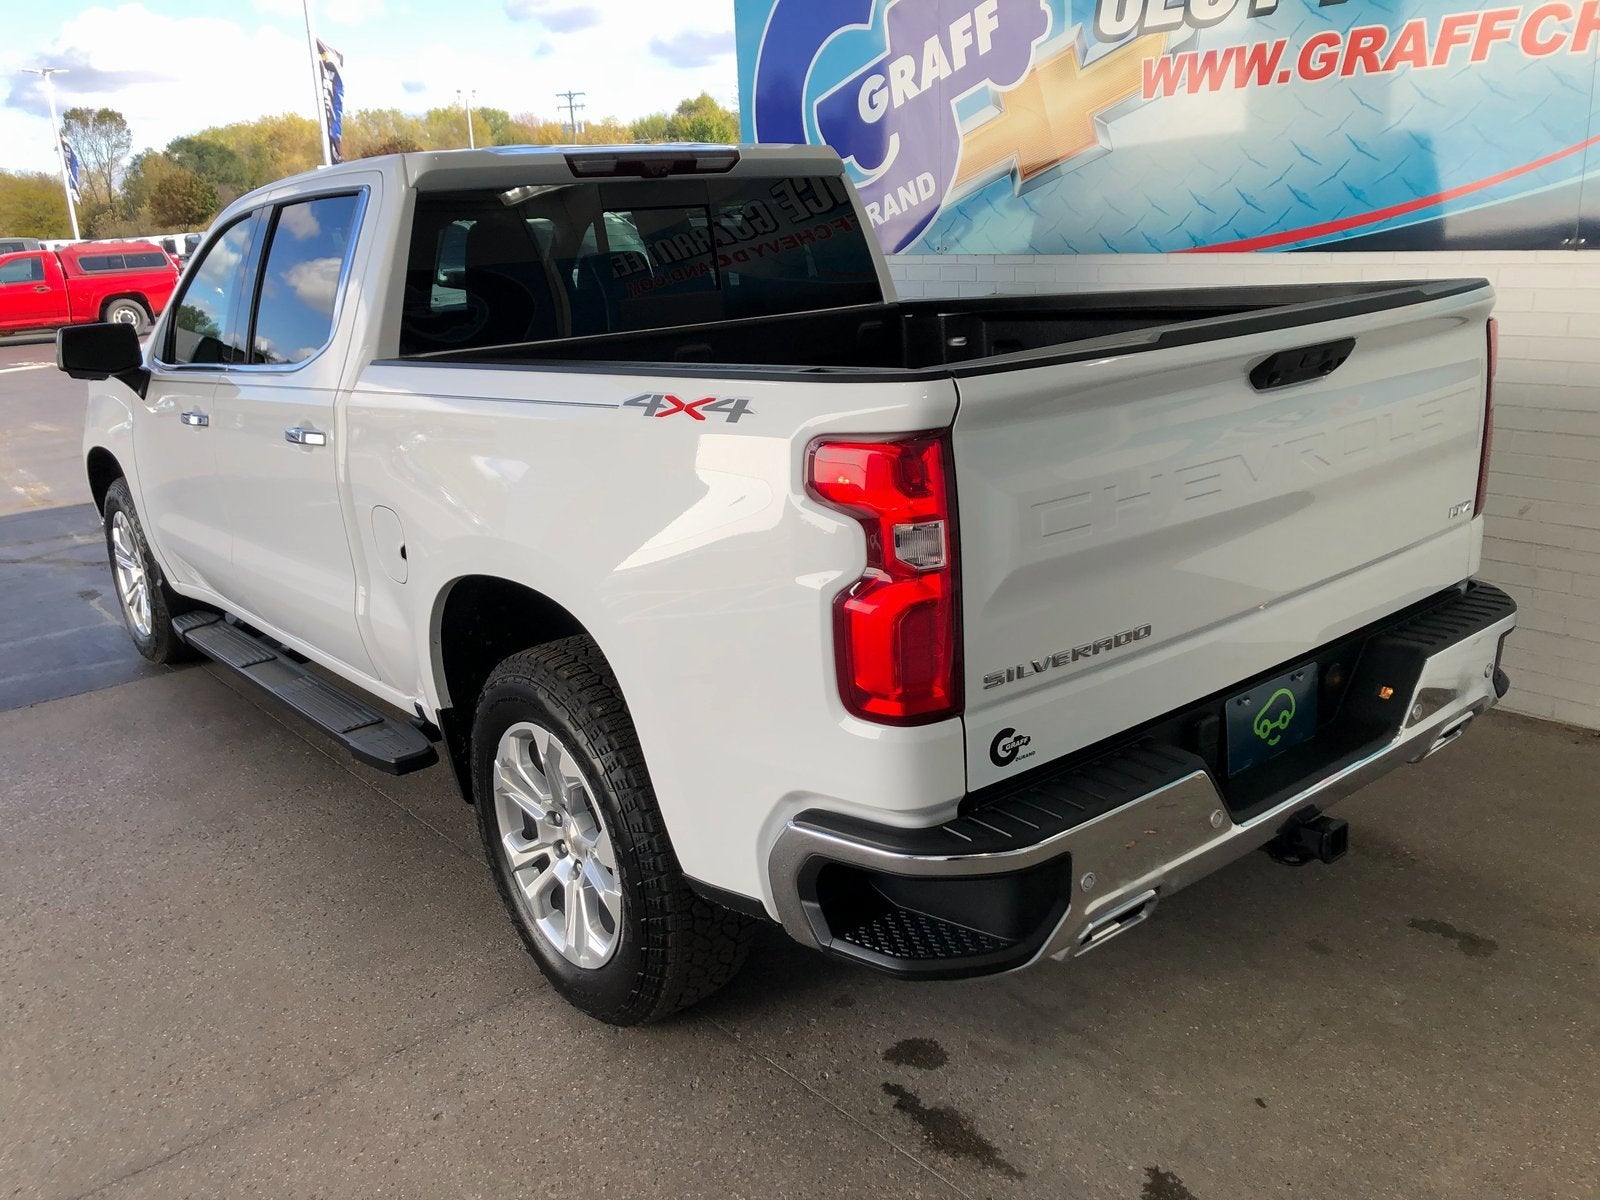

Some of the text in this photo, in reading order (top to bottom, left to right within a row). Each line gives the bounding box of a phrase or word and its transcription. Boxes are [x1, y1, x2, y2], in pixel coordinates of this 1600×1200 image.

[857, 0, 999, 125] GRAFF
[1448, 499, 1472, 520] LTZ
[982, 622, 1152, 690] SILVERADO
